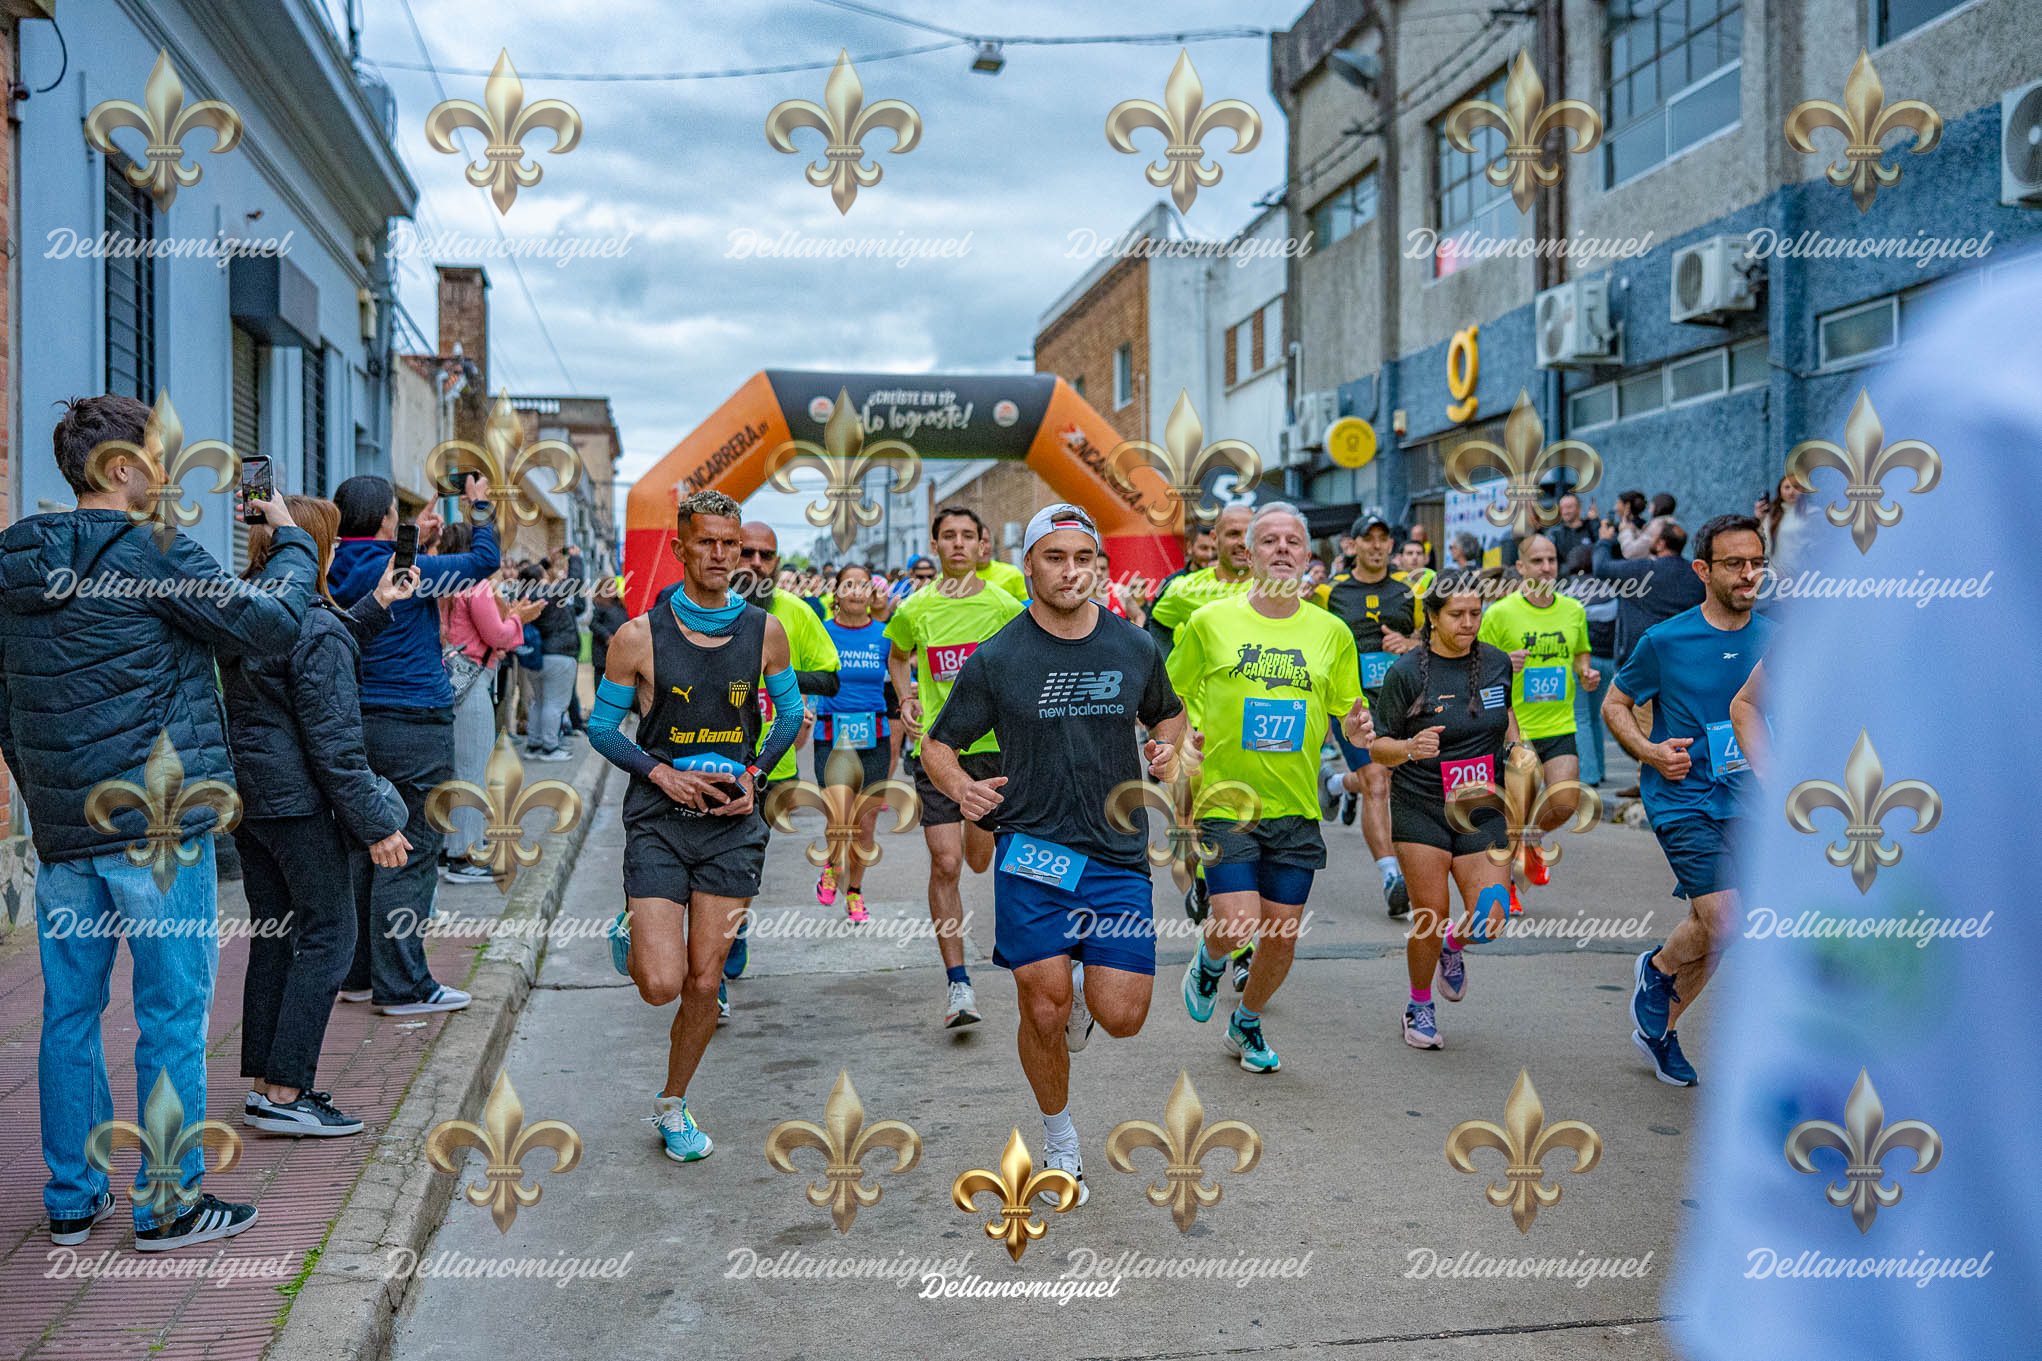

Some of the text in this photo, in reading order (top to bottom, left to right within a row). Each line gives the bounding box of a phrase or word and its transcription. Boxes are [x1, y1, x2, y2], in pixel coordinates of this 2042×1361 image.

[1243, 661, 1307, 680] CANELONES
[1530, 676, 1559, 694] 369
[1038, 702, 1125, 719] new balance
[669, 726, 695, 744] San
[1253, 714, 1296, 739] 377
[1724, 736, 1740, 760] 4
[1449, 762, 1489, 789] 208
[1016, 843, 1071, 876] 398
